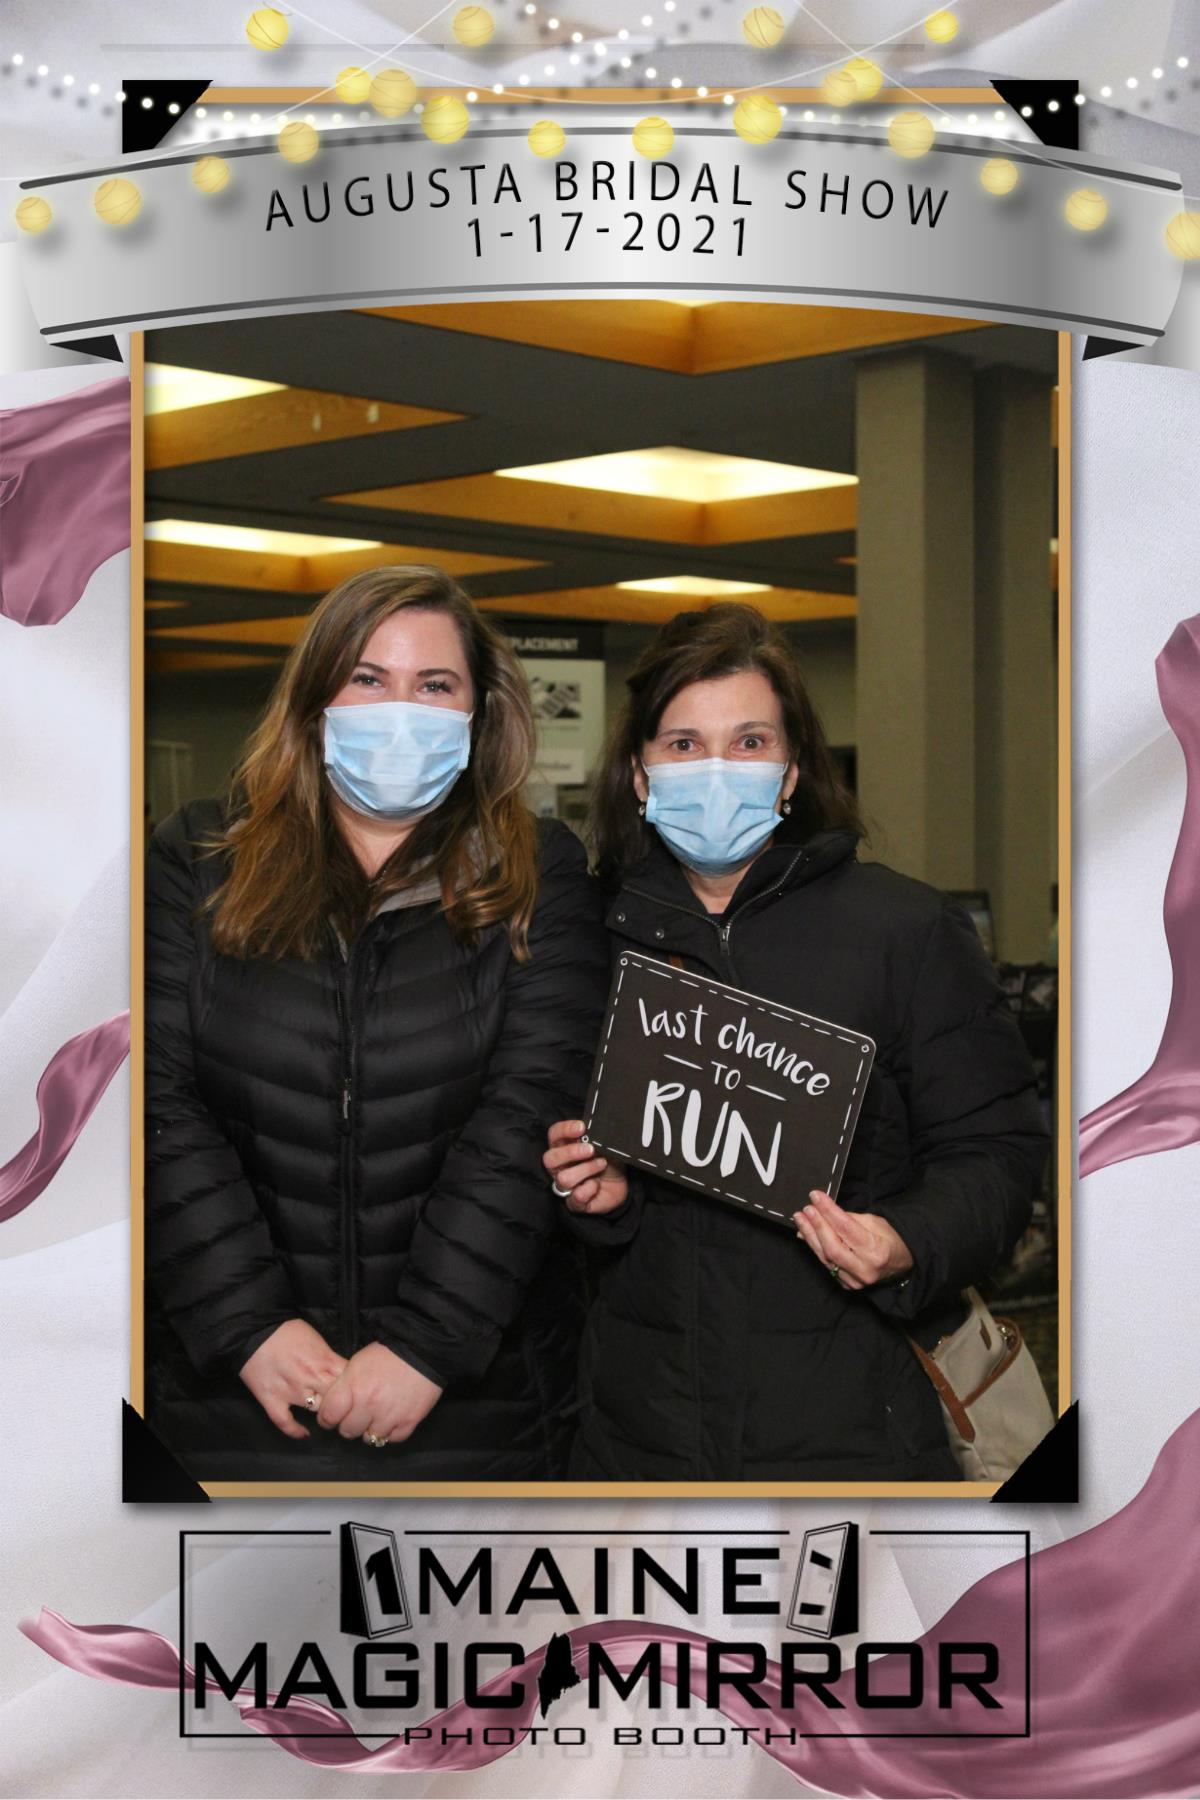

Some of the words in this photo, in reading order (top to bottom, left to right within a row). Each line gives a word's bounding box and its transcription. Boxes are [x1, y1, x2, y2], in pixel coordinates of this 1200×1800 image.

[638, 998, 709, 1046] last
[717, 1016, 831, 1096] chance
[711, 1060, 742, 1090] TO
[641, 1079, 782, 1187] RUN
